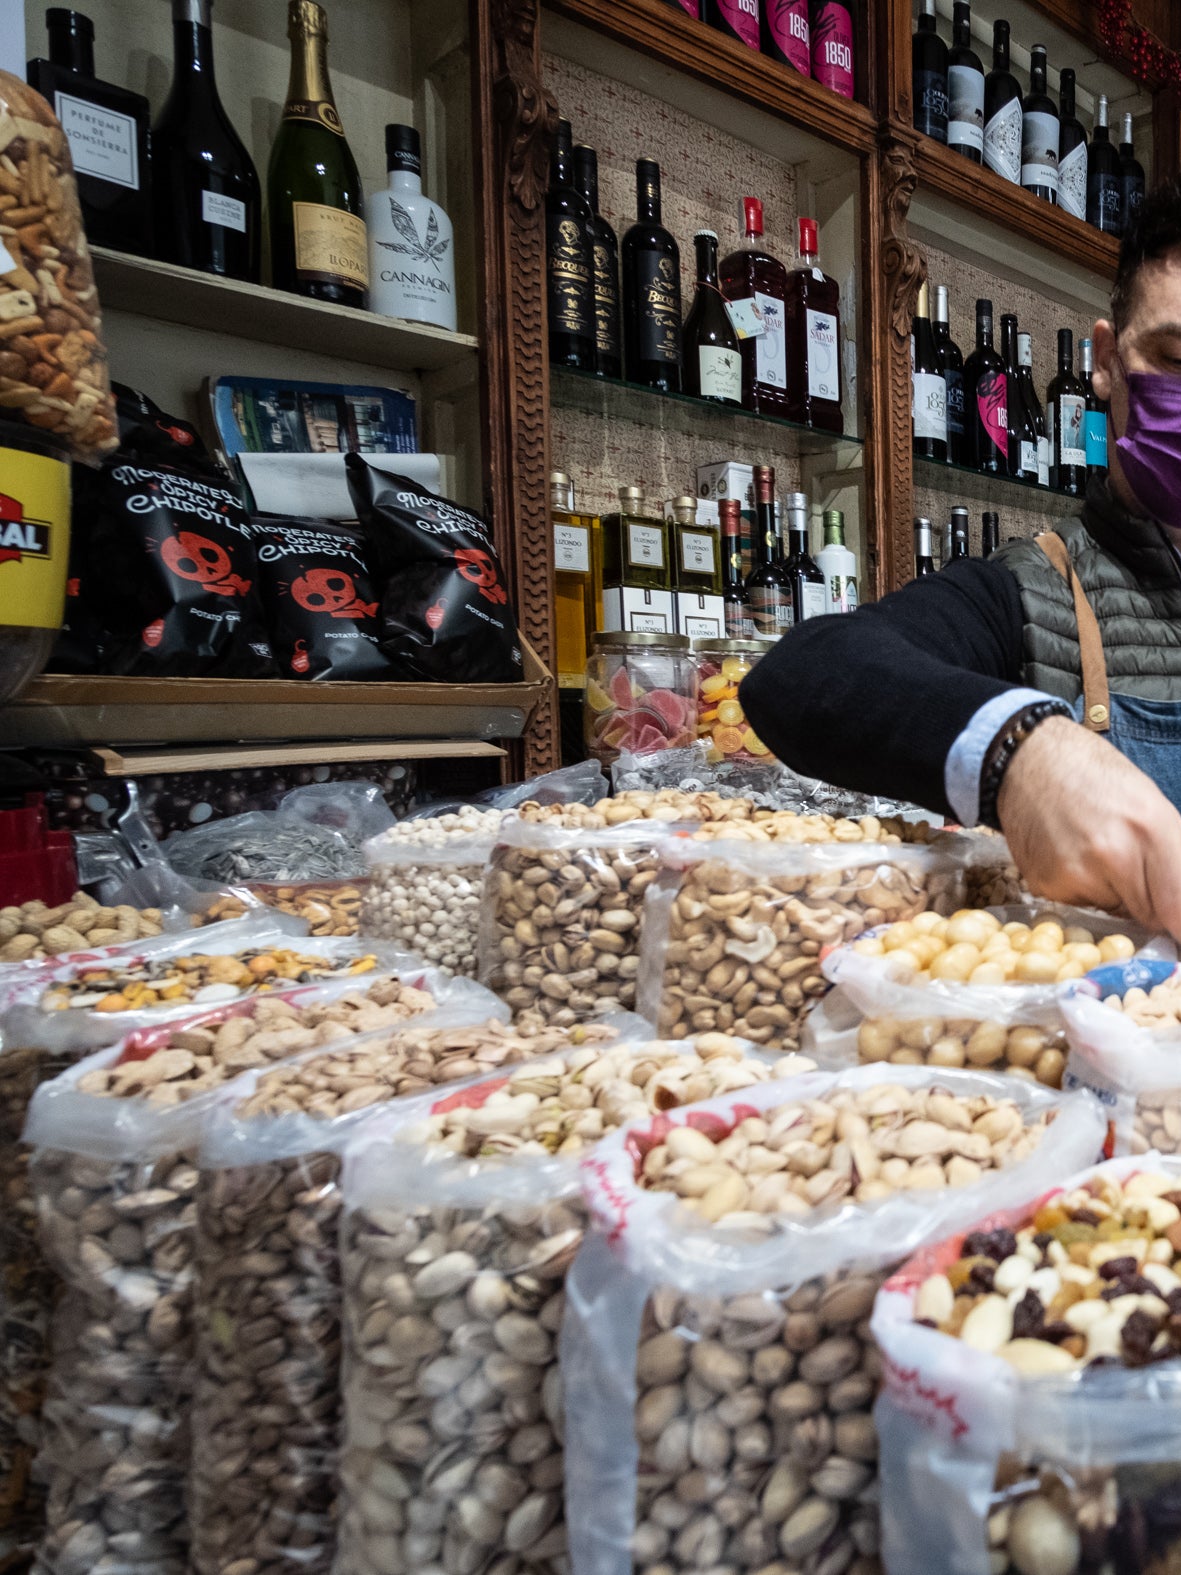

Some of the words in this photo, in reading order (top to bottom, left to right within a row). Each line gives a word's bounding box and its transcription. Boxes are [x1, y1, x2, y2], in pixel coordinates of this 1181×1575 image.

[825, 41, 851, 73] 1850
[71, 109, 121, 134] PERFUME
[92, 126, 104, 137] DE
[380, 269, 451, 294] CANNAGIN
[810, 329, 834, 344] SADAR
[160, 479, 218, 509] SPICY
[126, 494, 251, 540] CHIPOTLE
[437, 507, 477, 530] SPICY
[285, 534, 341, 550] SPICY
[556, 538, 582, 547] LIZONDO
[634, 537, 658, 545] ELIZONDO
[190, 607, 222, 622] POTATO
[465, 604, 490, 622] POTATO
